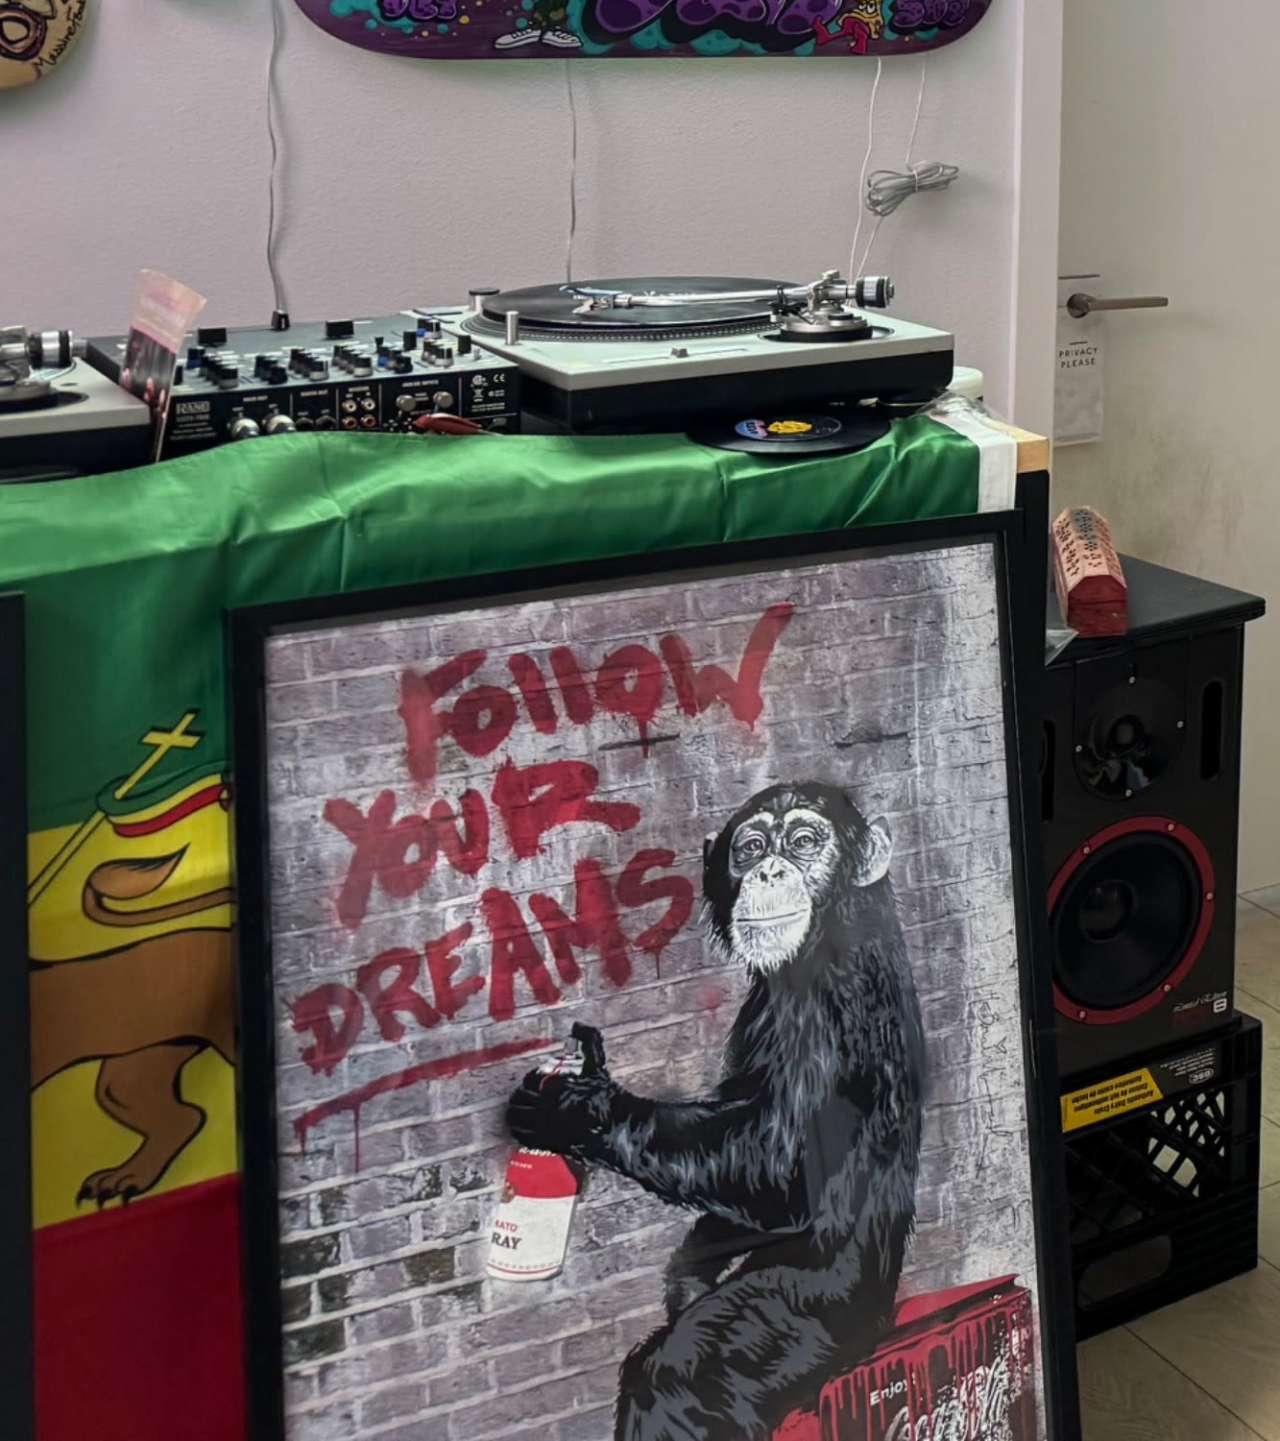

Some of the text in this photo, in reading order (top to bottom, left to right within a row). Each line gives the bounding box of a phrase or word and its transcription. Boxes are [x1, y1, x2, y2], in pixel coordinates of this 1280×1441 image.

[1058, 346, 1098, 358] PRIVACY
[1060, 357, 1096, 368] PLEASE
[322, 756, 642, 931] YOUR
[285, 847, 695, 1077] DREAMS
[490, 1231, 523, 1250] RAY
